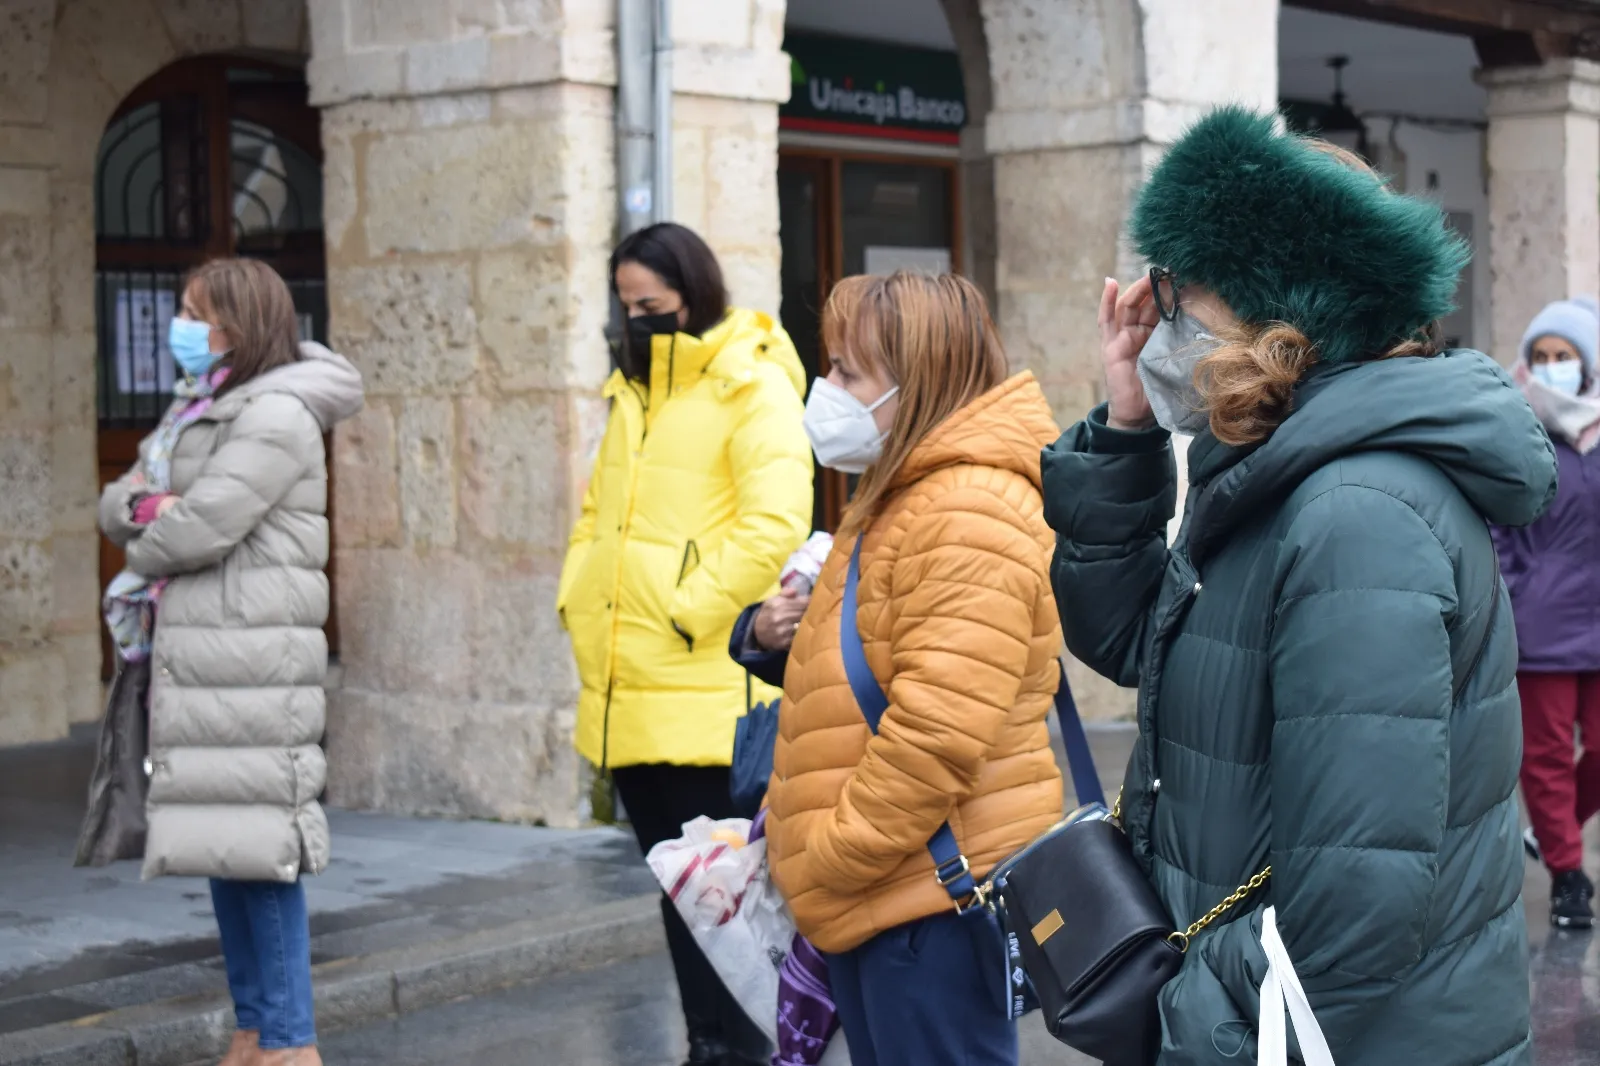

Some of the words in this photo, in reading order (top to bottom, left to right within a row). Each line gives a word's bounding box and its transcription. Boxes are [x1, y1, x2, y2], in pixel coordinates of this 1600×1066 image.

[810, 76, 896, 124] Unicaja
[898, 86, 965, 125] Banco
[1008, 931, 1020, 959] LOVE
